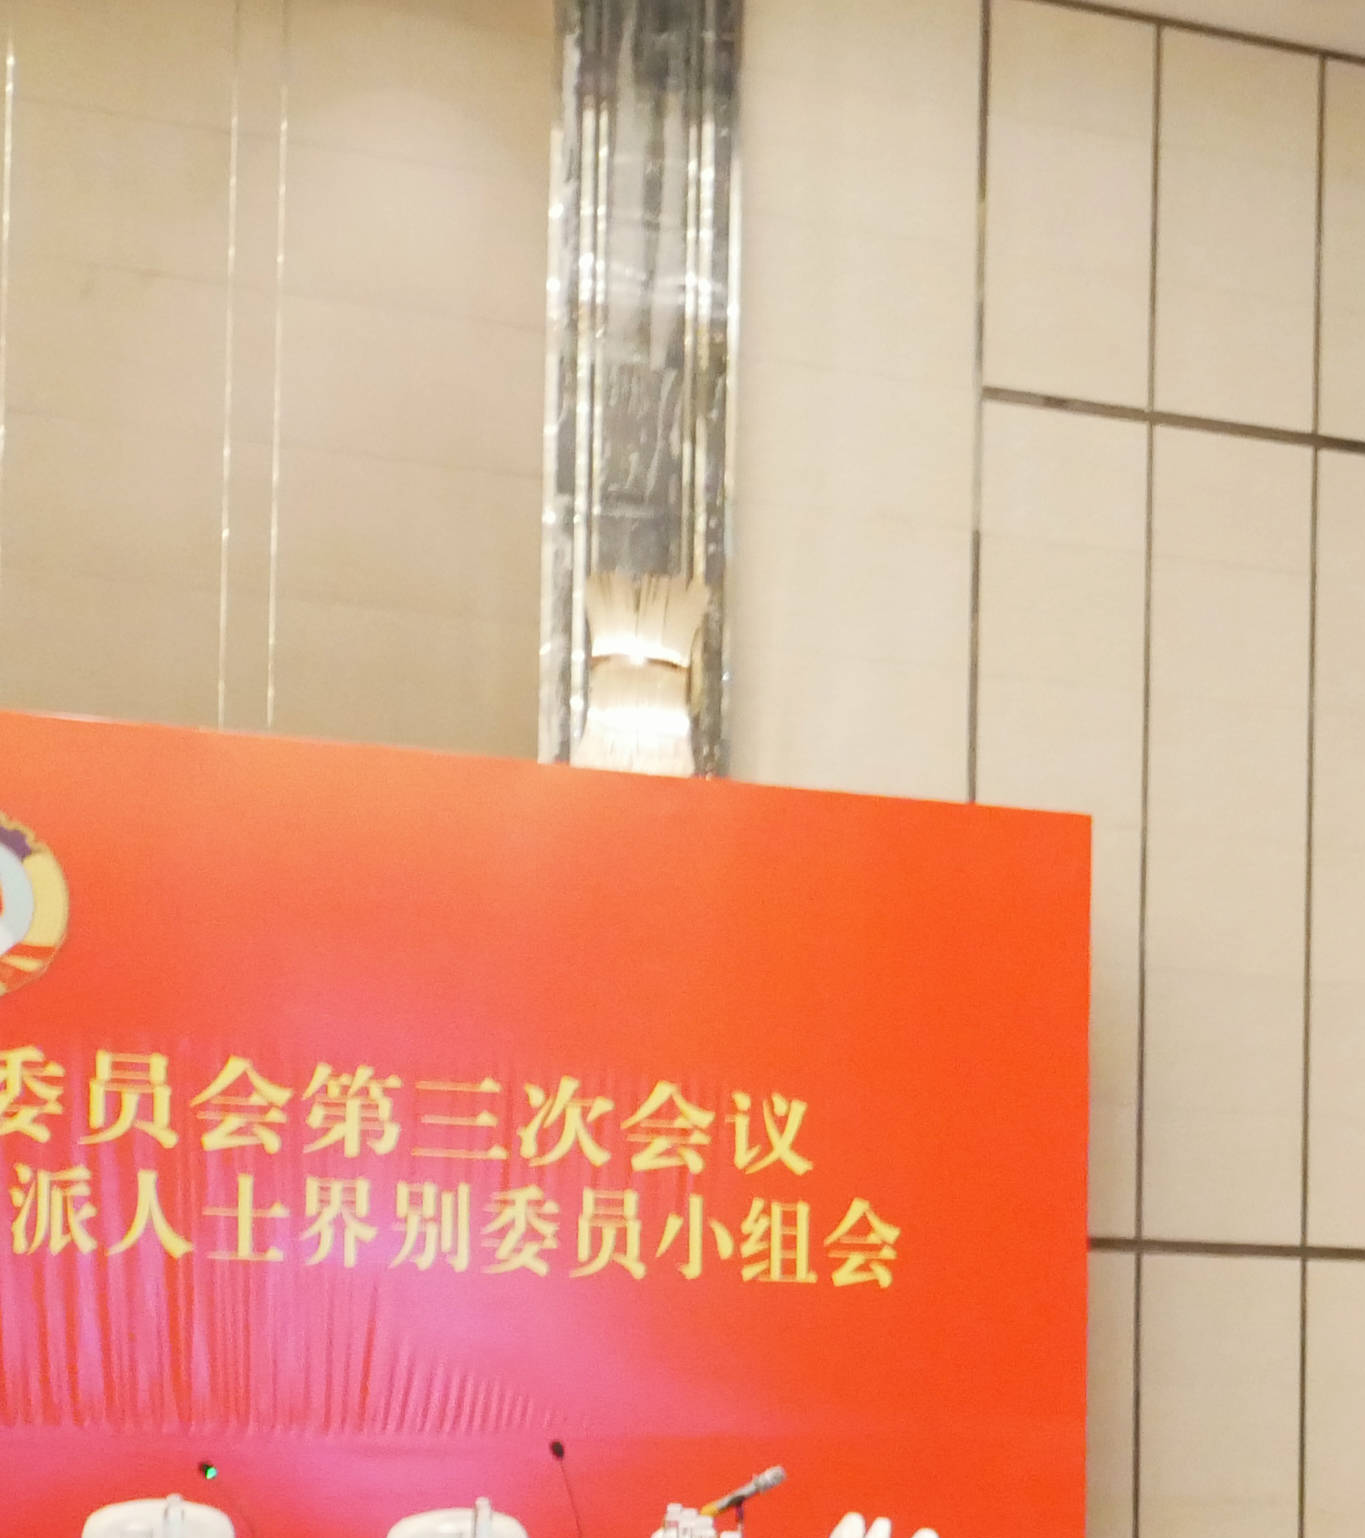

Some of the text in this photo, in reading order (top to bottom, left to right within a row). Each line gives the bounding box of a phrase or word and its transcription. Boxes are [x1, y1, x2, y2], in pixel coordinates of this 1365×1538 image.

[0, 1045, 814, 1177] 委员会第三次会议
[10, 1162, 901, 1289] 派人士界别委员小组会
